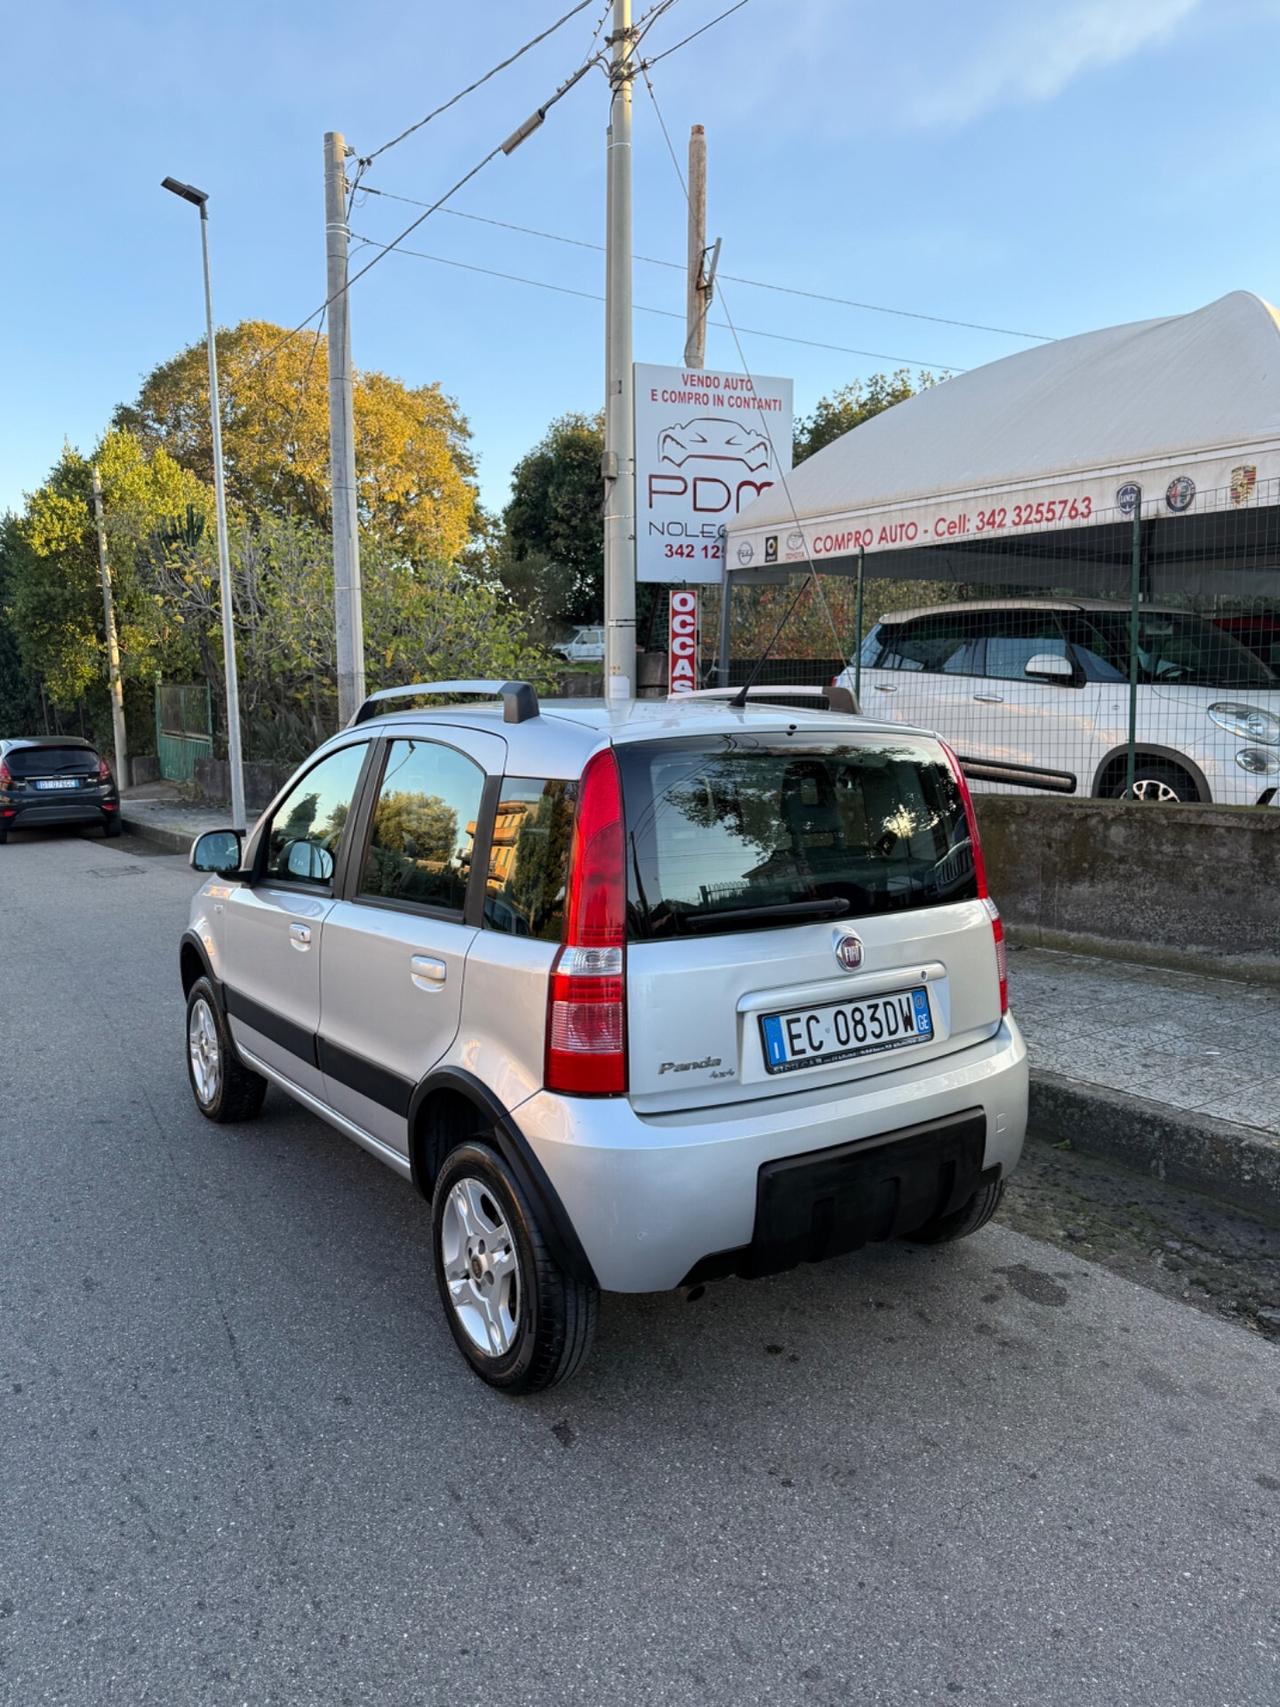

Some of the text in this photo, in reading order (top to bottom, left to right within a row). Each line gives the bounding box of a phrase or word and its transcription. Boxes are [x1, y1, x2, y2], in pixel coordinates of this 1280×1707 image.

[682, 373, 753, 391] VENDO AUTO
[650, 389, 782, 411] E COMPRO IN CONTANTI
[813, 528, 873, 553] COMPRO
[878, 522, 918, 544] AUTO
[934, 513, 971, 537] Cell:
[976, 507, 1007, 531] 342
[1012, 496, 1092, 526] 3255763
[664, 543, 695, 558] 342
[786, 1015, 824, 1056] EC
[833, 996, 915, 1046] 083DW
[917, 1013, 930, 1031] GE
[658, 1056, 722, 1075] Panda
